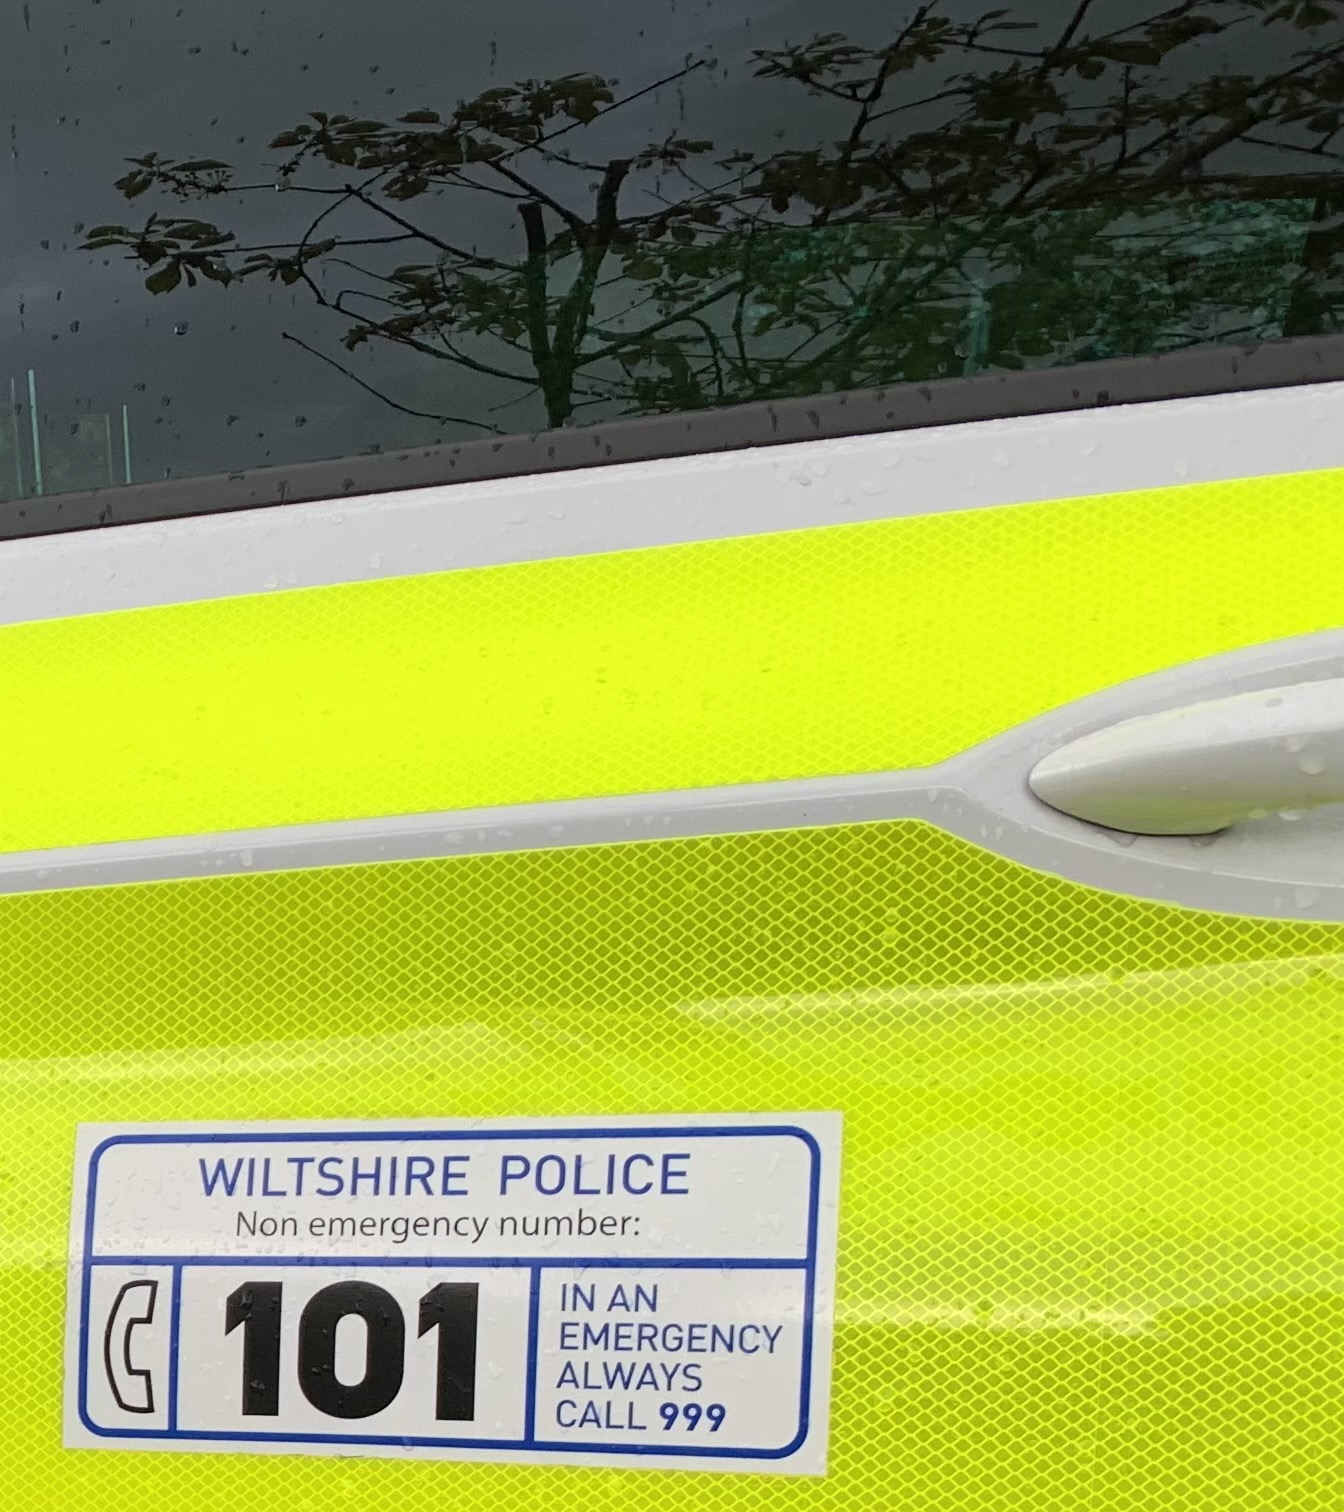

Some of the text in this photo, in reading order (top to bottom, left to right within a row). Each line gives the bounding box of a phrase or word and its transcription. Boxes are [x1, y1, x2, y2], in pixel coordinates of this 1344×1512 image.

[198, 1153, 691, 1198] WILTSHIRE POLICE
[236, 1209, 642, 1245] Non emergency number:
[560, 1283, 658, 1313] IN AN
[223, 1280, 480, 1422] 101
[559, 1323, 783, 1356] EMERGENCY
[556, 1362, 703, 1393] ALWAYS
[554, 1400, 727, 1434] CALL 999
